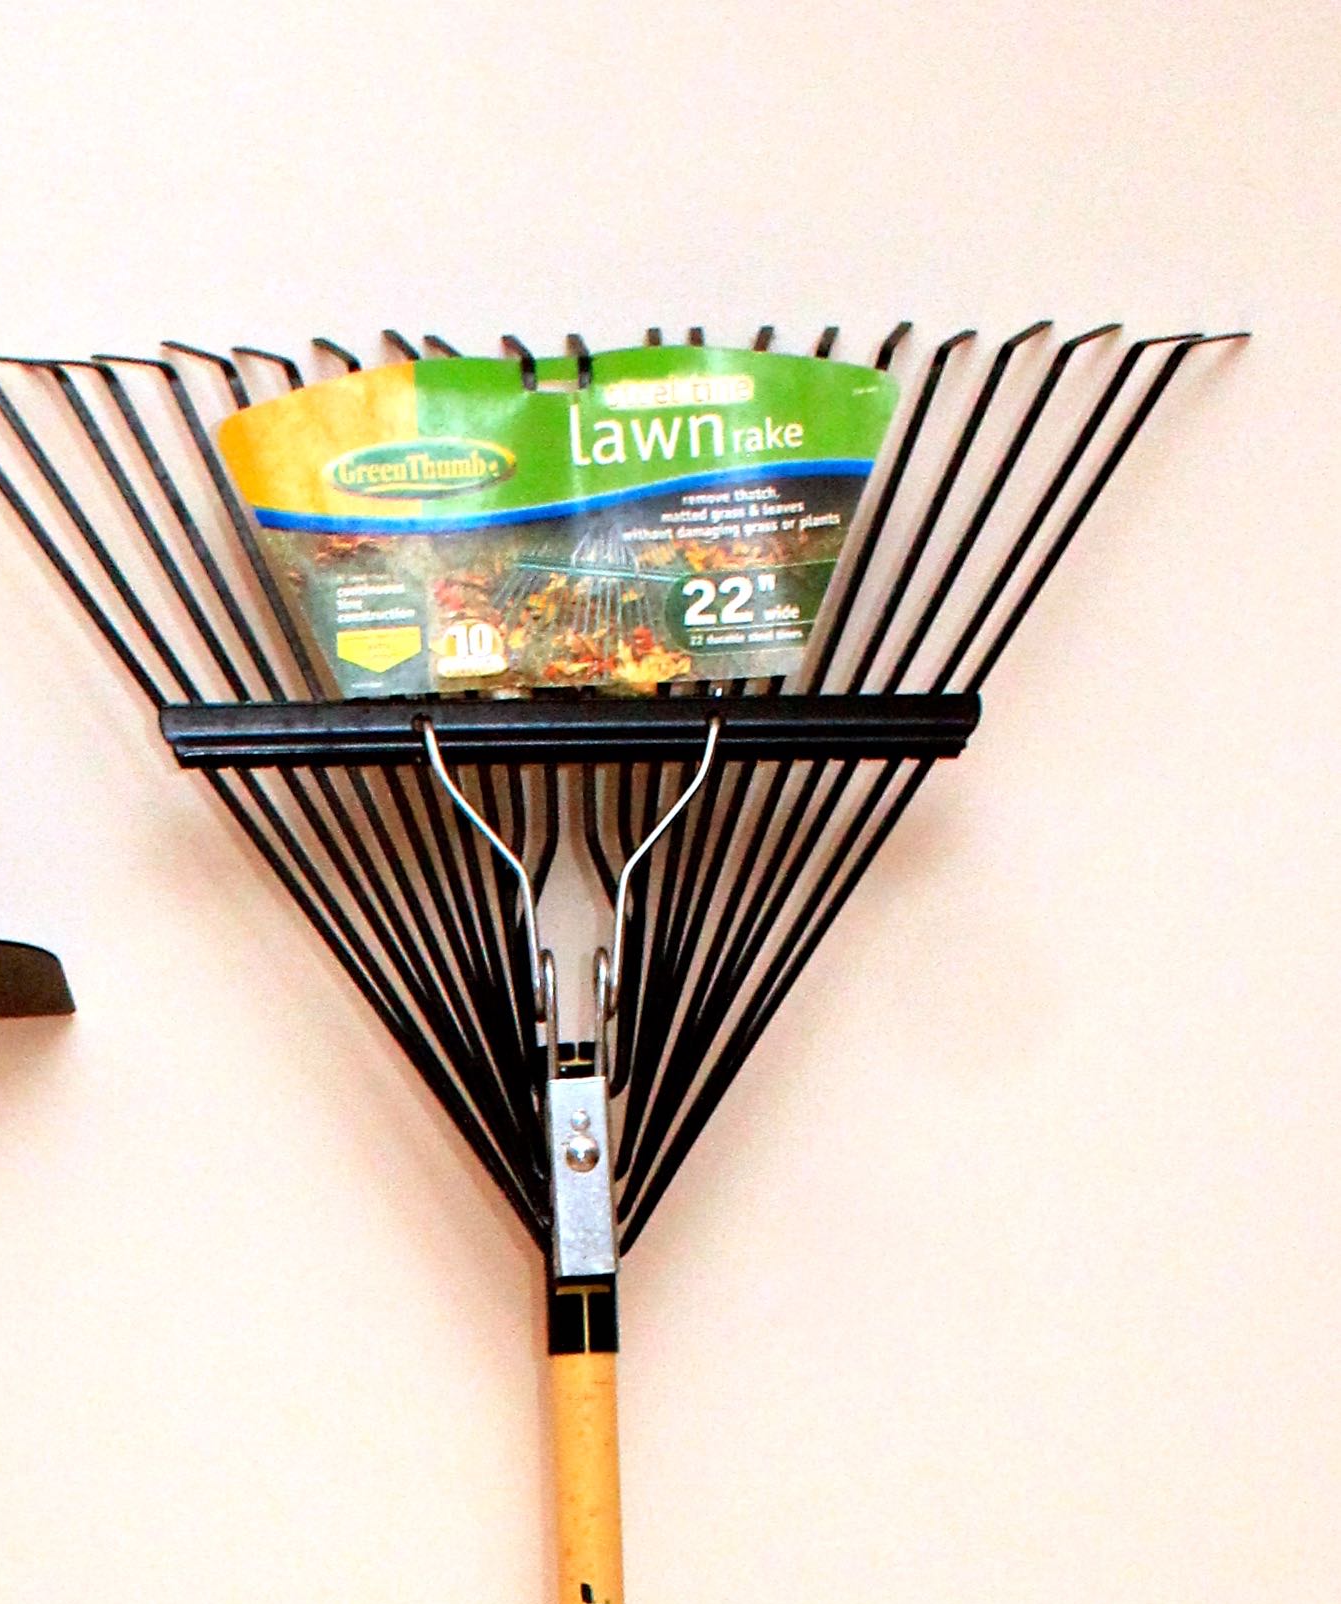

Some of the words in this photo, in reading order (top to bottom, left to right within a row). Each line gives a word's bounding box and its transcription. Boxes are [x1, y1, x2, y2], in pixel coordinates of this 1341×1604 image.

[570, 403, 725, 466] lawn
[733, 417, 803, 453] rake
[337, 449, 487, 484] GreenThumb
[763, 604, 800, 621] wide
[446, 623, 494, 656] 10
